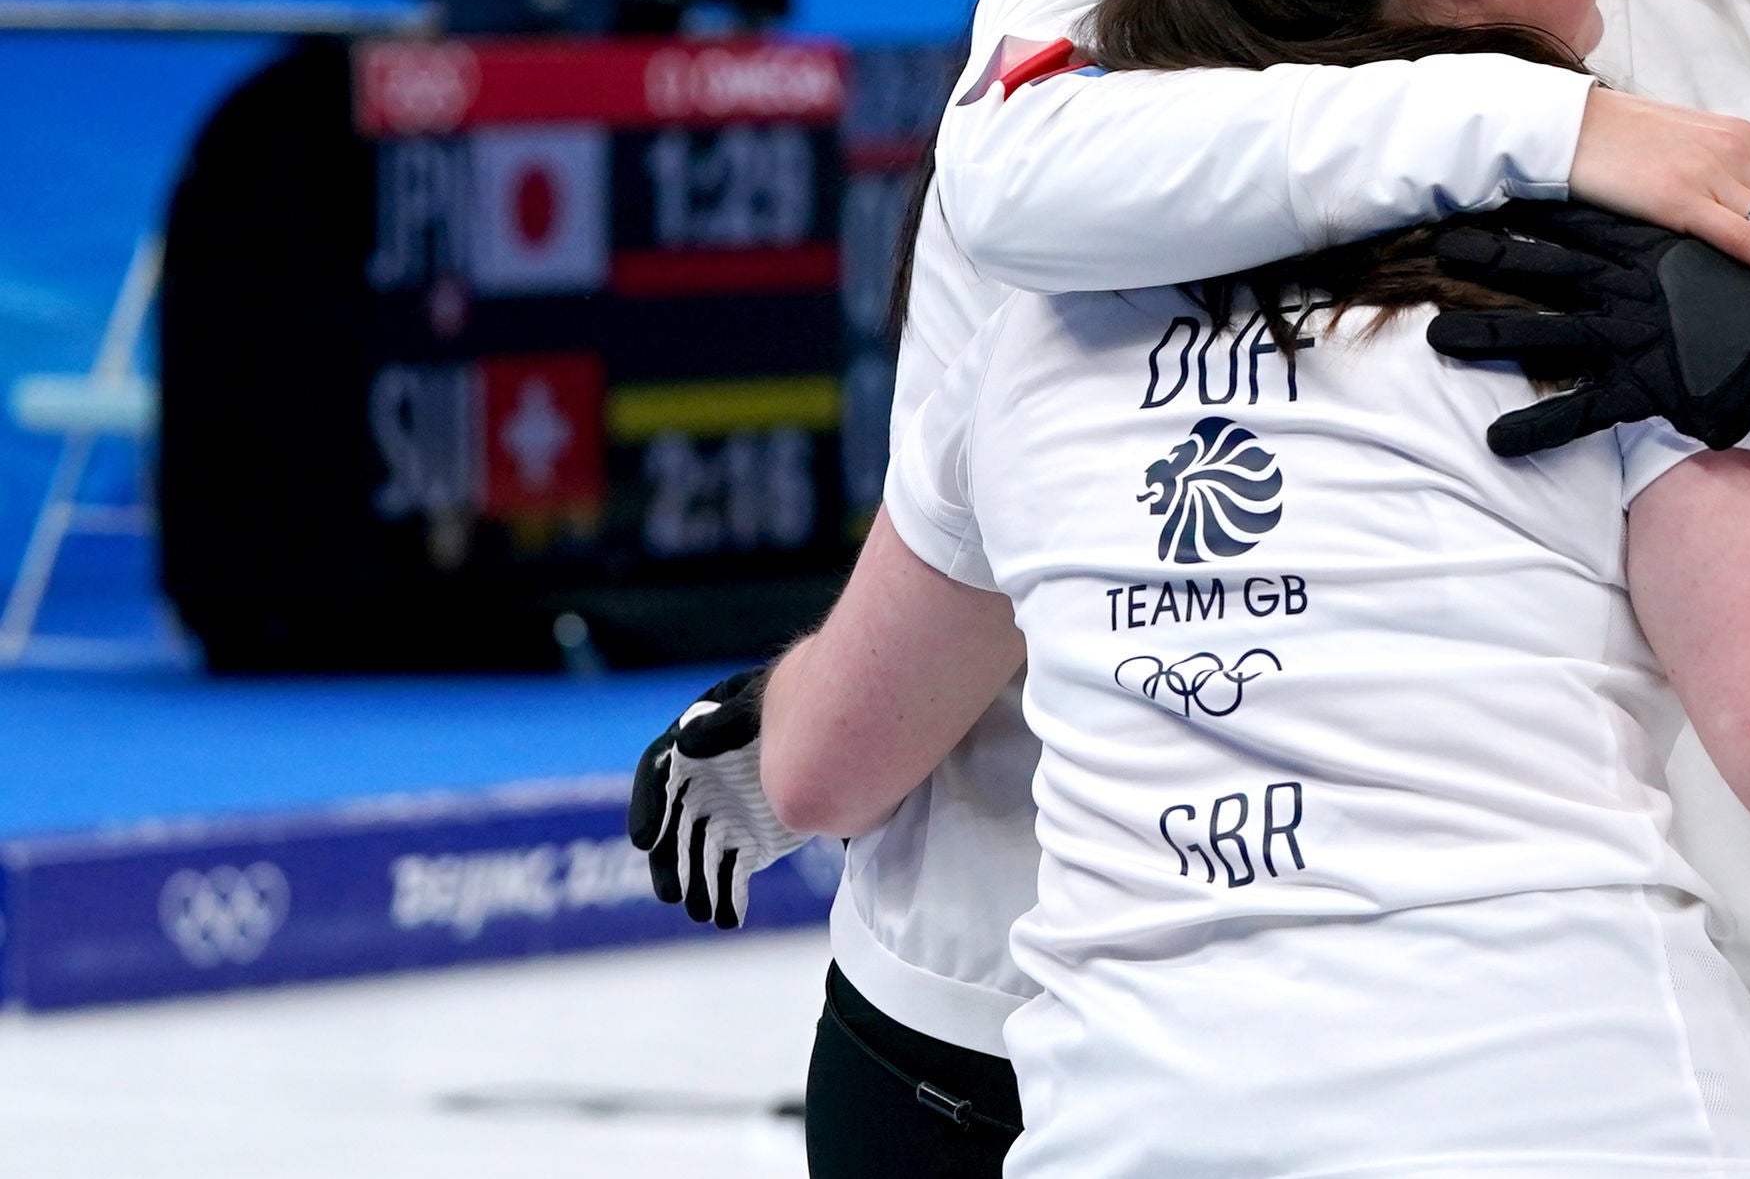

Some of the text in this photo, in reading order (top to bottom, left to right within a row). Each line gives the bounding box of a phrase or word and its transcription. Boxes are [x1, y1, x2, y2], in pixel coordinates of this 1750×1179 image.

[1140, 301, 1332, 409] DUFF
[1106, 575, 1308, 631] TEAM GB
[1159, 782, 1306, 889] GBR
